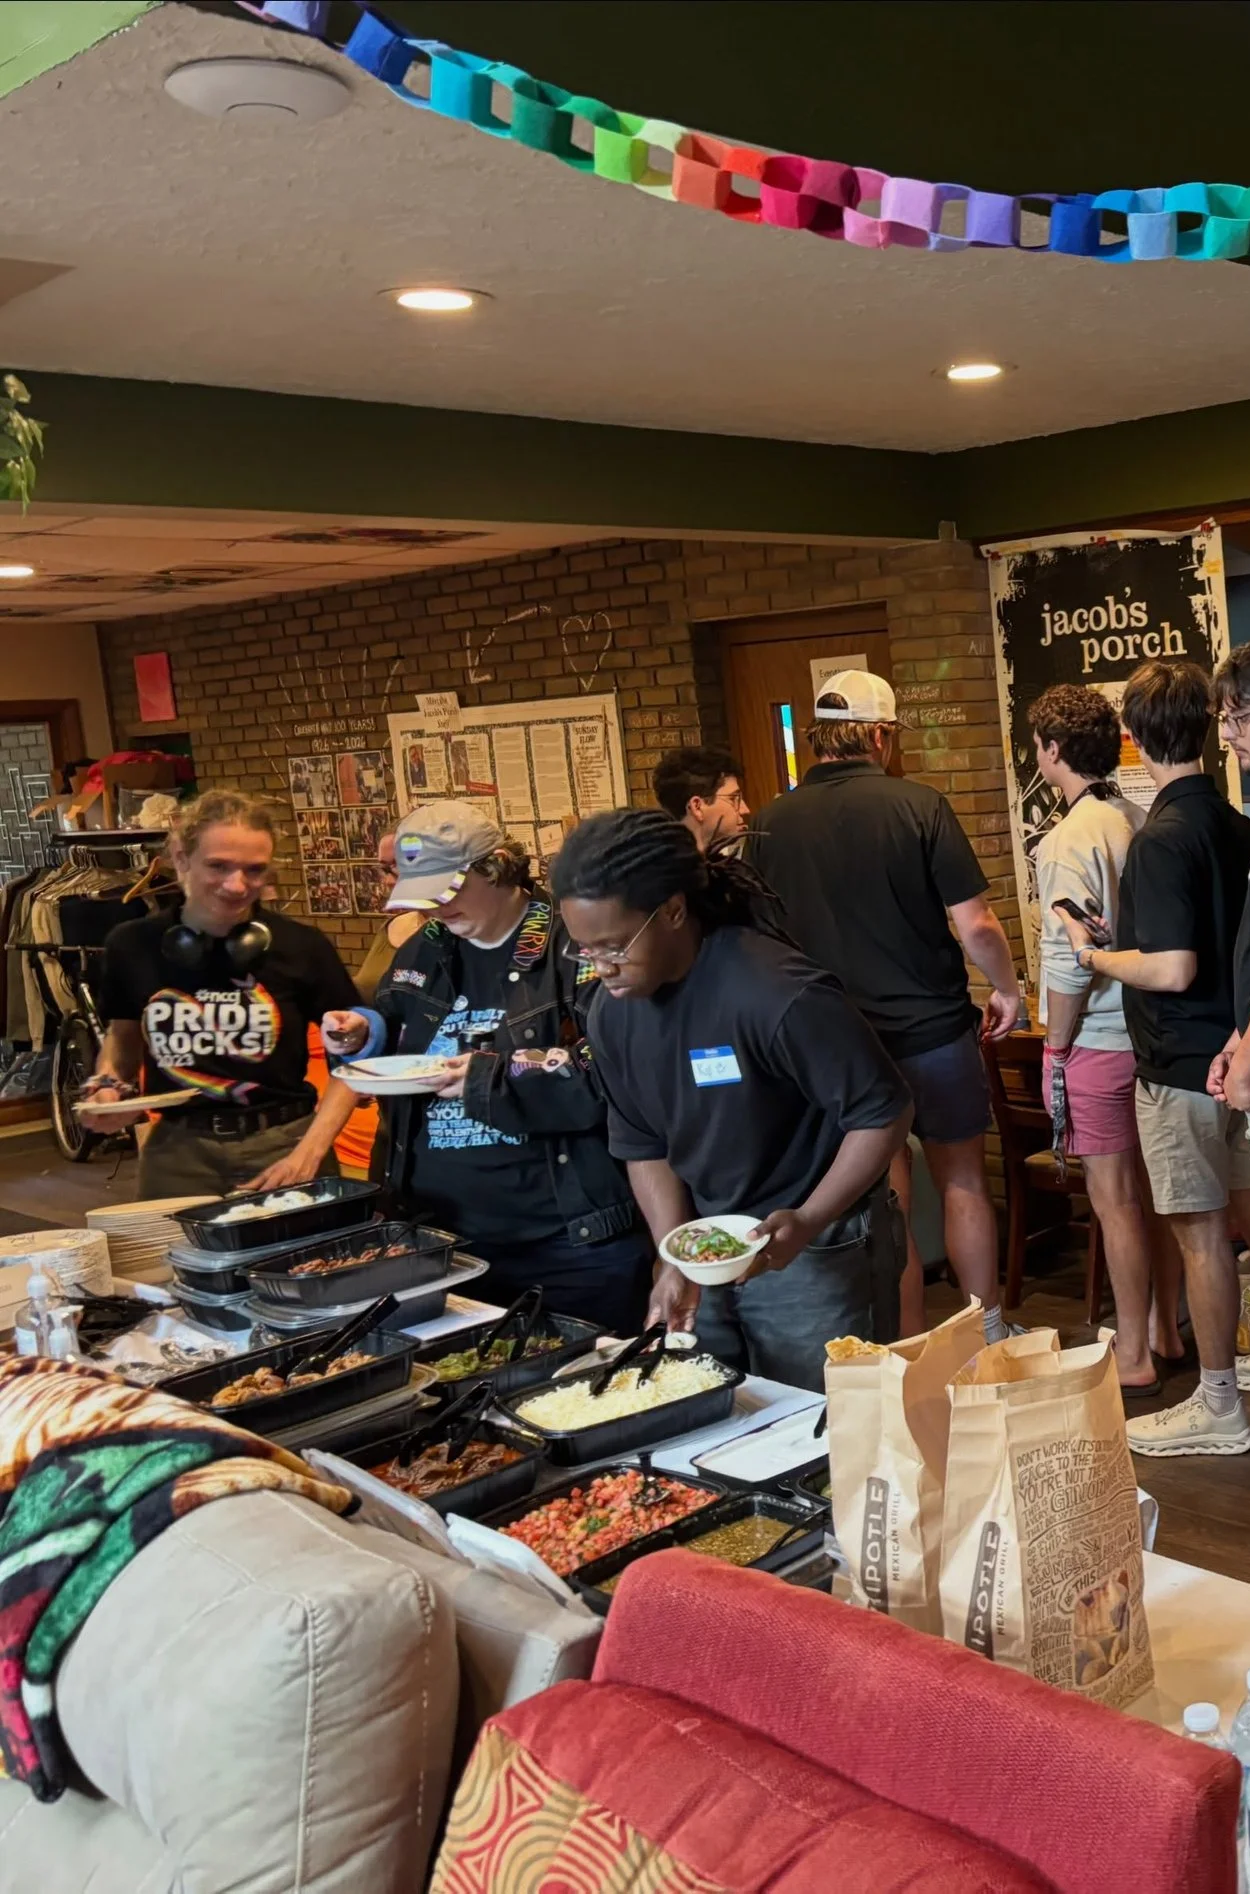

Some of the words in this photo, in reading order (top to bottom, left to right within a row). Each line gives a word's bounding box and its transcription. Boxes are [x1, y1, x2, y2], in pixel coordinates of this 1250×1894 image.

[1040, 586, 1148, 647] jacob's
[1080, 622, 1187, 674] porch
[147, 1001, 273, 1032] PRIDE
[150, 1032, 273, 1056] ROCKS!
[157, 1053, 195, 1067] 2023
[1016, 1448, 1041, 1467] DON'T
[1018, 1460, 1055, 1490] FACE
[1056, 1456, 1069, 1470] TO
[1072, 1453, 1092, 1466] THE
[1018, 1473, 1063, 1508] YOU'RE
[1065, 1468, 1086, 1485] NOT
[1072, 1570, 1097, 1593] THIS
